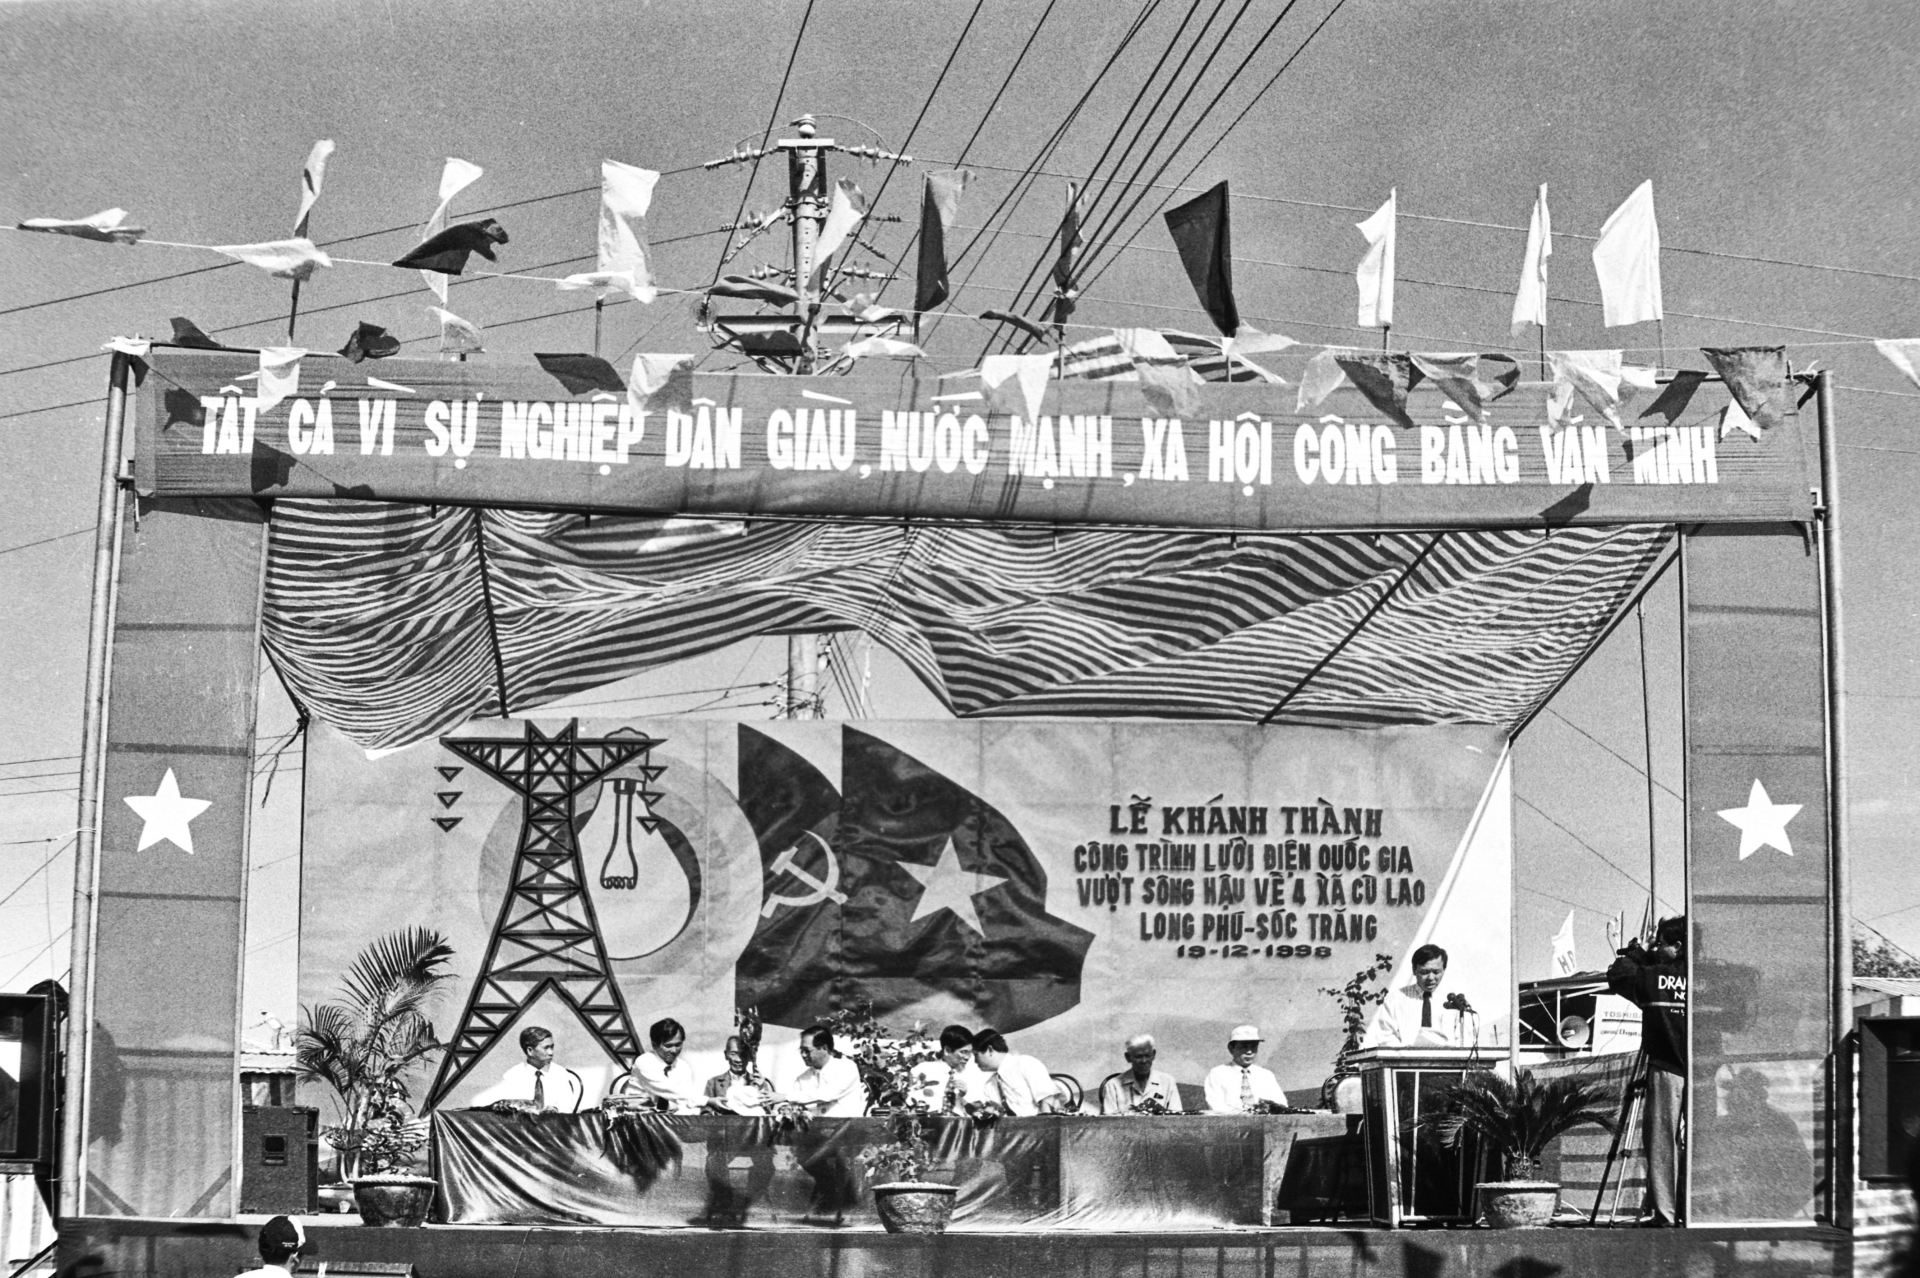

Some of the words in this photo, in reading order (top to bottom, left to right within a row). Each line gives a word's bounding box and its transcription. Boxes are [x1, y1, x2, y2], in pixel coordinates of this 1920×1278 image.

[201, 371, 268, 455] TẤT
[288, 380, 336, 455] CẢ
[358, 376, 416, 456] VÌ
[424, 392, 484, 470] SỰ
[500, 393, 650, 476] NGHIỆP
[665, 397, 742, 469] DÂN
[879, 391, 989, 475] NƯỚC
[1208, 411, 1272, 497] HỘI
[1294, 413, 1398, 485] CÔNG
[1421, 400, 1520, 484] BẰNG
[1631, 426, 1718, 484] MINH
[1109, 793, 1152, 834] LỄ
[1162, 793, 1267, 835] KHÁNH
[1280, 797, 1383, 837] THÀNH
[1073, 841, 1129, 873] CÔNG
[1135, 837, 1196, 871] TRÌNH
[1203, 836, 1254, 872] LƯỚI
[1263, 839, 1311, 878] ĐIỆN
[1378, 845, 1413, 873] GIA
[1076, 871, 1134, 912] VƯỢT
[1142, 875, 1195, 906] SÔNG
[1203, 873, 1245, 911] HẬU
[1254, 871, 1285, 906] VỀ
[1292, 878, 1306, 906] 4
[1317, 873, 1346, 906] XÃ
[1351, 874, 1377, 905] CÙ
[1385, 877, 1426, 906] LAO
[1140, 912, 1195, 941] LONG
[1307, 908, 1378, 942] TRĂNG
[1177, 944, 1332, 958] 19-12-1998
